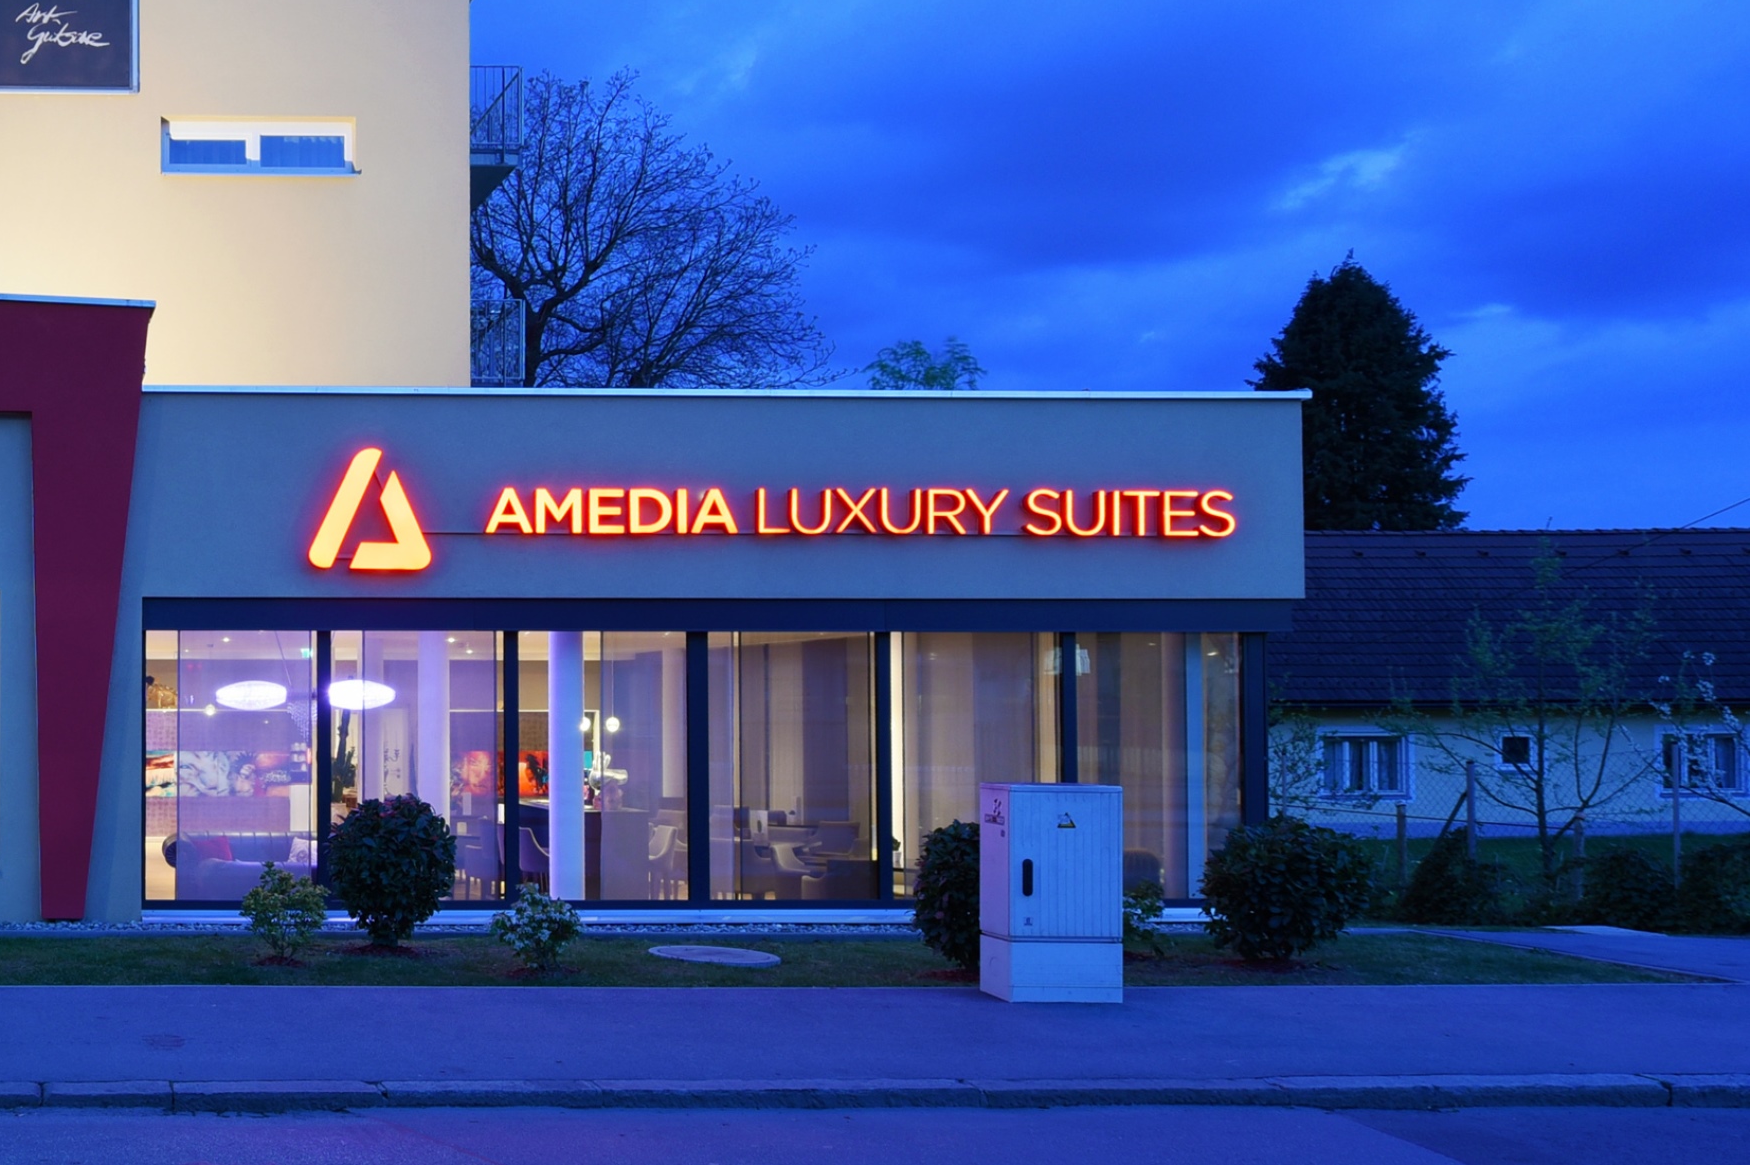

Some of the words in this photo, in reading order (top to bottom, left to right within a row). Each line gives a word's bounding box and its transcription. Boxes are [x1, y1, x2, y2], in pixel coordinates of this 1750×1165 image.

[484, 487, 739, 534] AMEDIA
[757, 487, 1009, 535] LUXURY
[1024, 489, 1236, 537] SUITES
